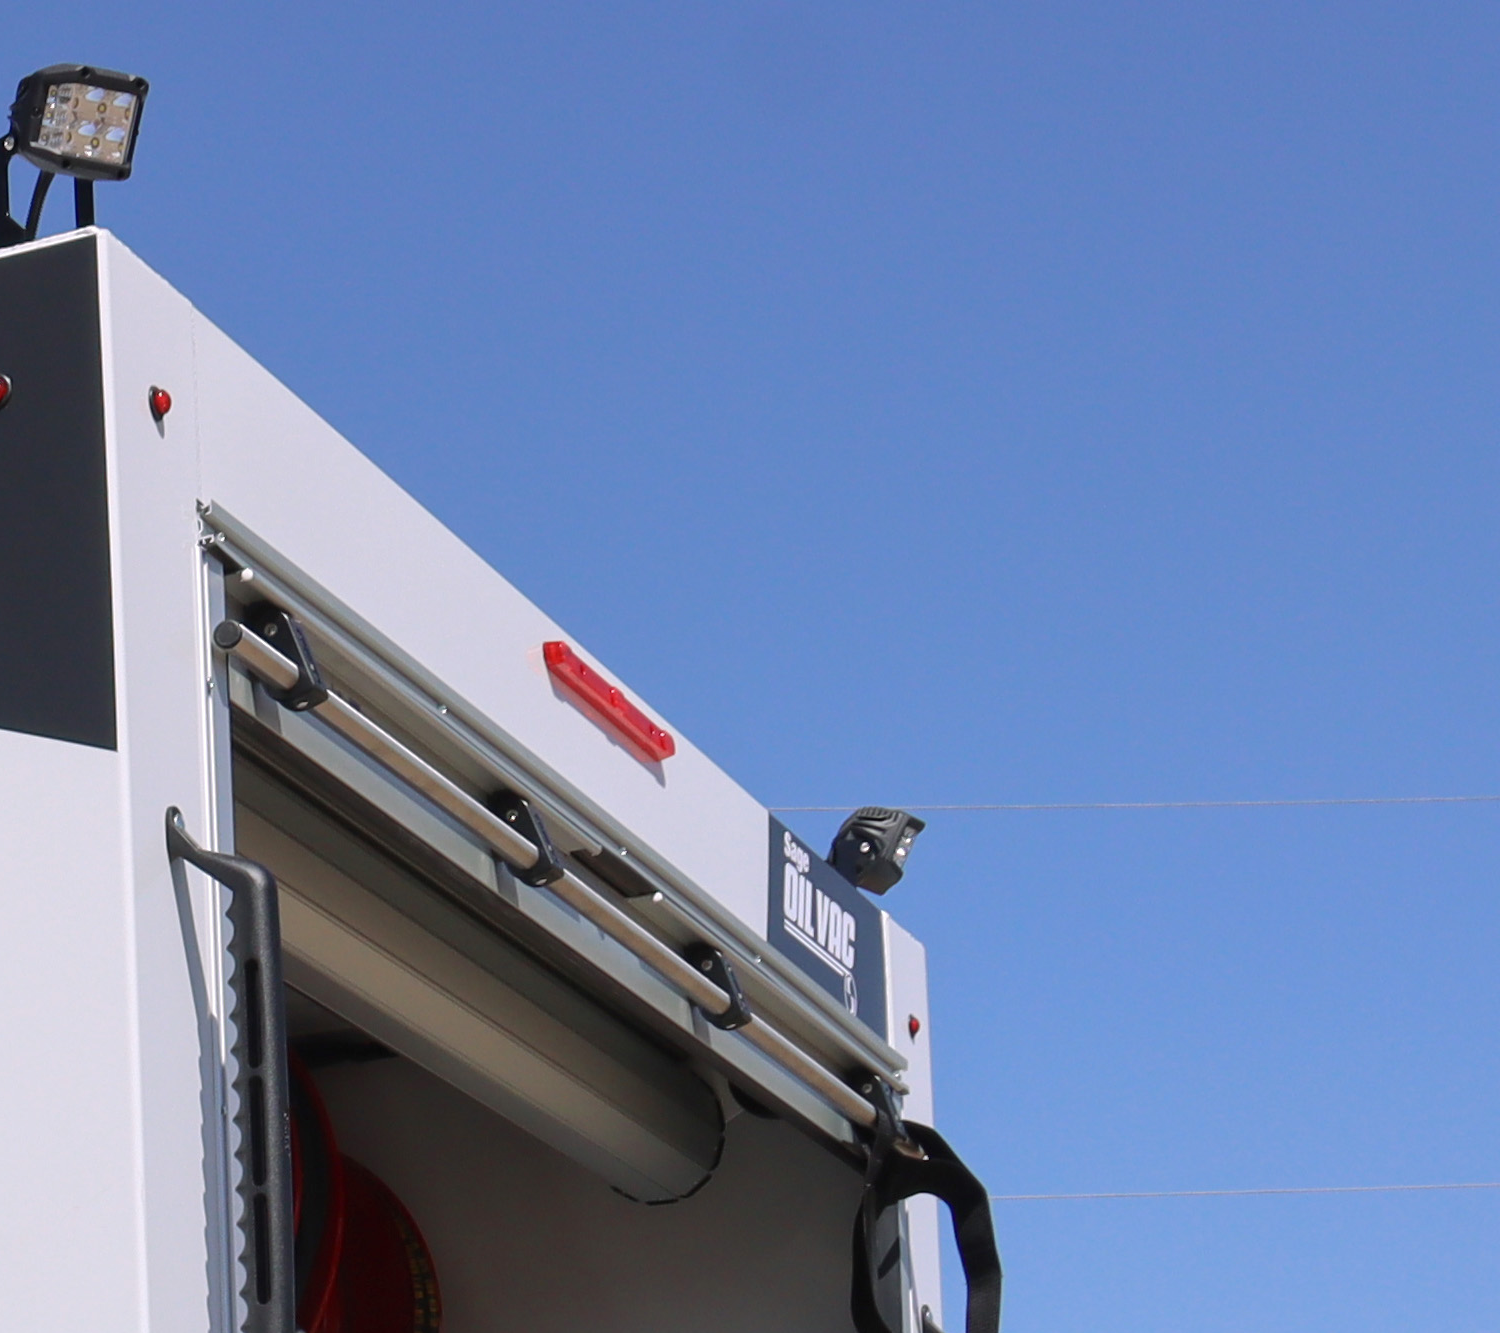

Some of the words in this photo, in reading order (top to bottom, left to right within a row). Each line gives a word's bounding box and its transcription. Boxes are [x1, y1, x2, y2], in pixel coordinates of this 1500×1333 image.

[783, 831, 810, 873] Sage
[783, 862, 815, 938] OIL
[816, 888, 856, 969] VAC
